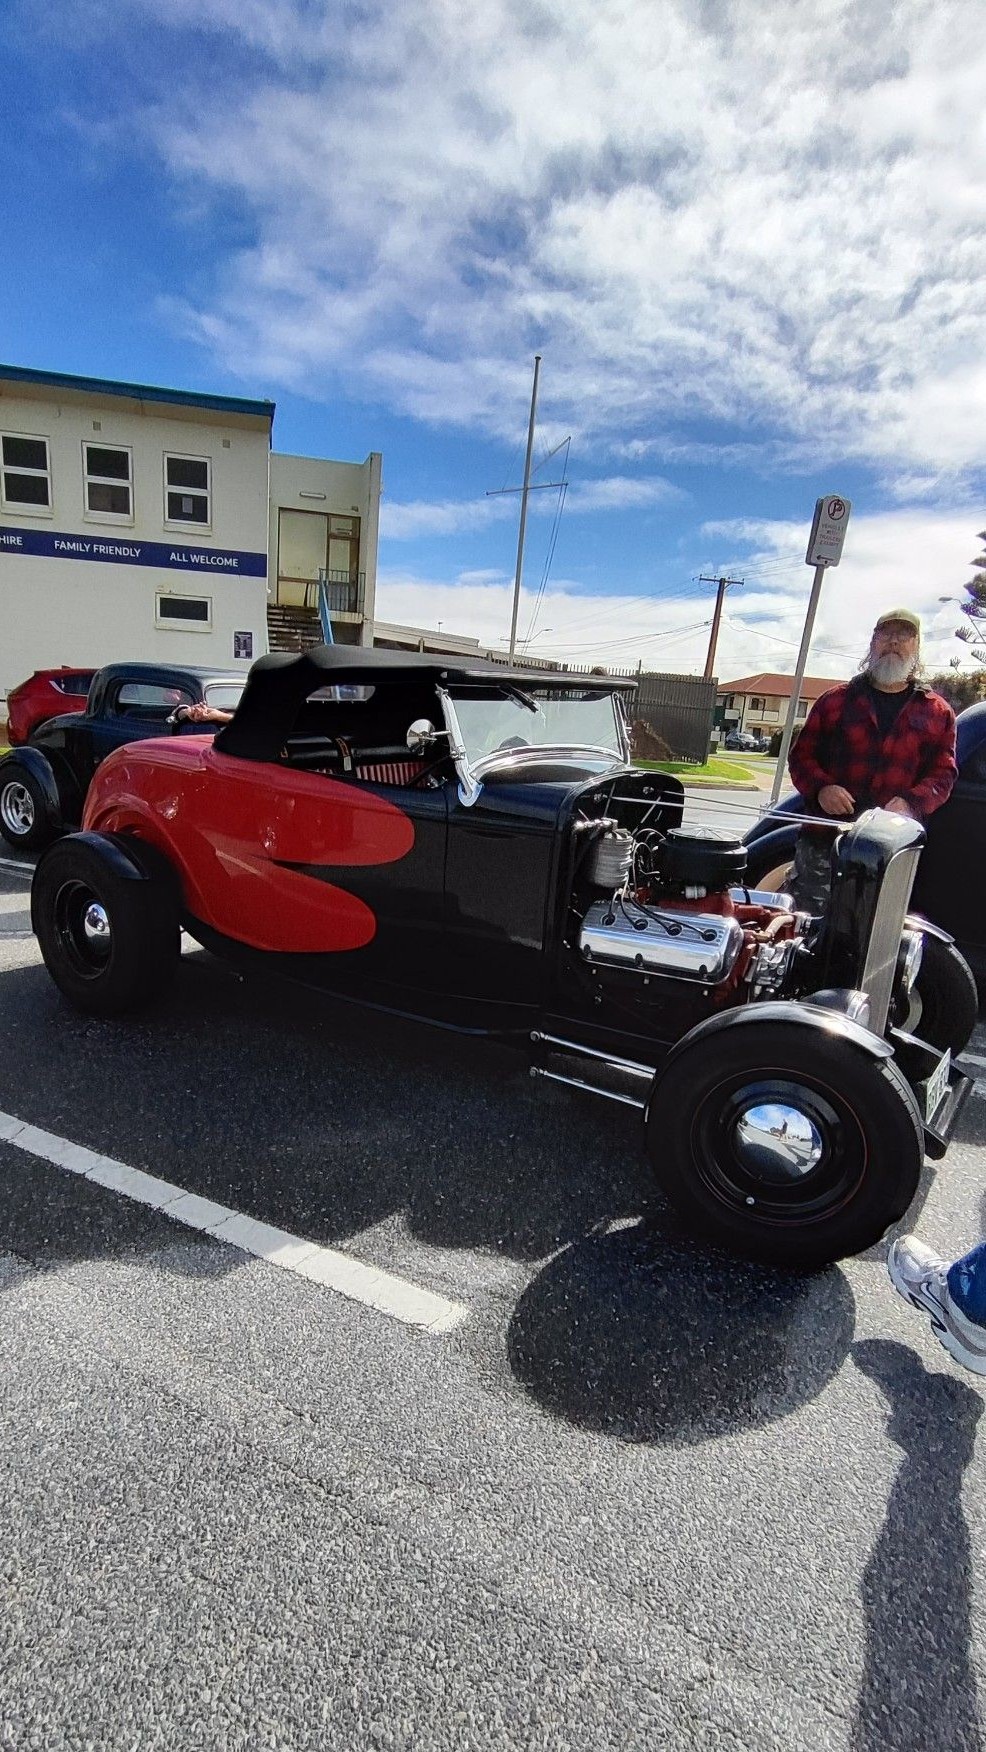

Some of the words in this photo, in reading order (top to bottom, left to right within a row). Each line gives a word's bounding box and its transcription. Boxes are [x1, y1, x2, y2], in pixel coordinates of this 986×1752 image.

[54, 540, 91, 553] FAMILY
[93, 544, 141, 557] FRIENDLY
[169, 552, 188, 563] ALL
[190, 554, 239, 567] WELCOME
